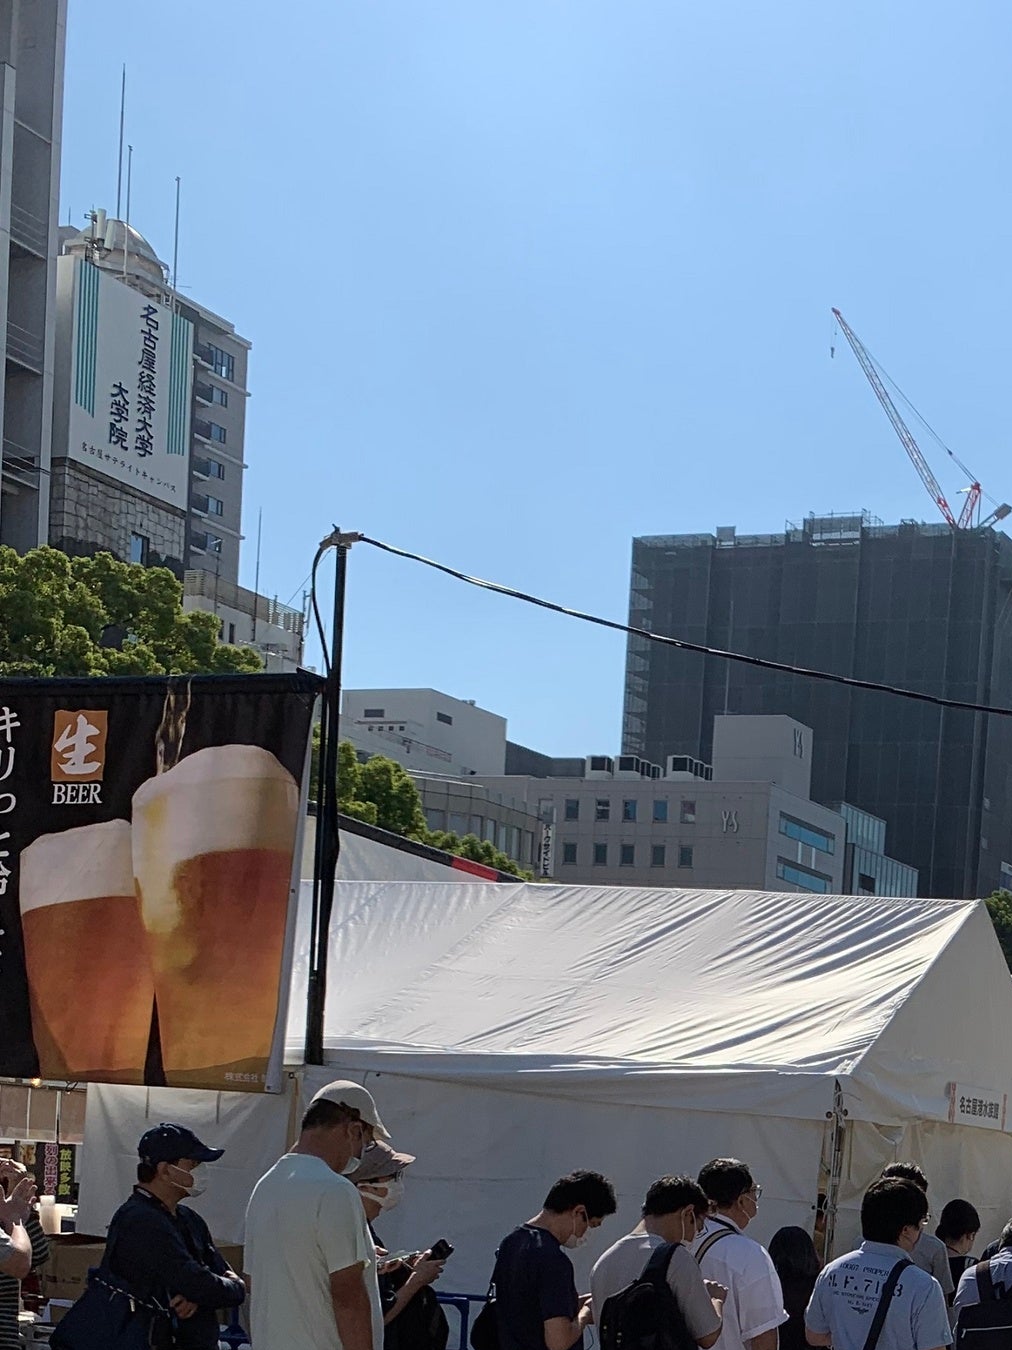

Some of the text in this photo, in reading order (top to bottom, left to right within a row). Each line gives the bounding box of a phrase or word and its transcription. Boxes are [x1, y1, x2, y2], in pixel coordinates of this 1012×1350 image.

[135, 304, 159, 458] 名古屋経済大学
[109, 382, 129, 451] 大学院
[54, 714, 102, 774] 生
[51, 783, 103, 804] BEER
[959, 1095, 1000, 1120] 名古屋港水族館
